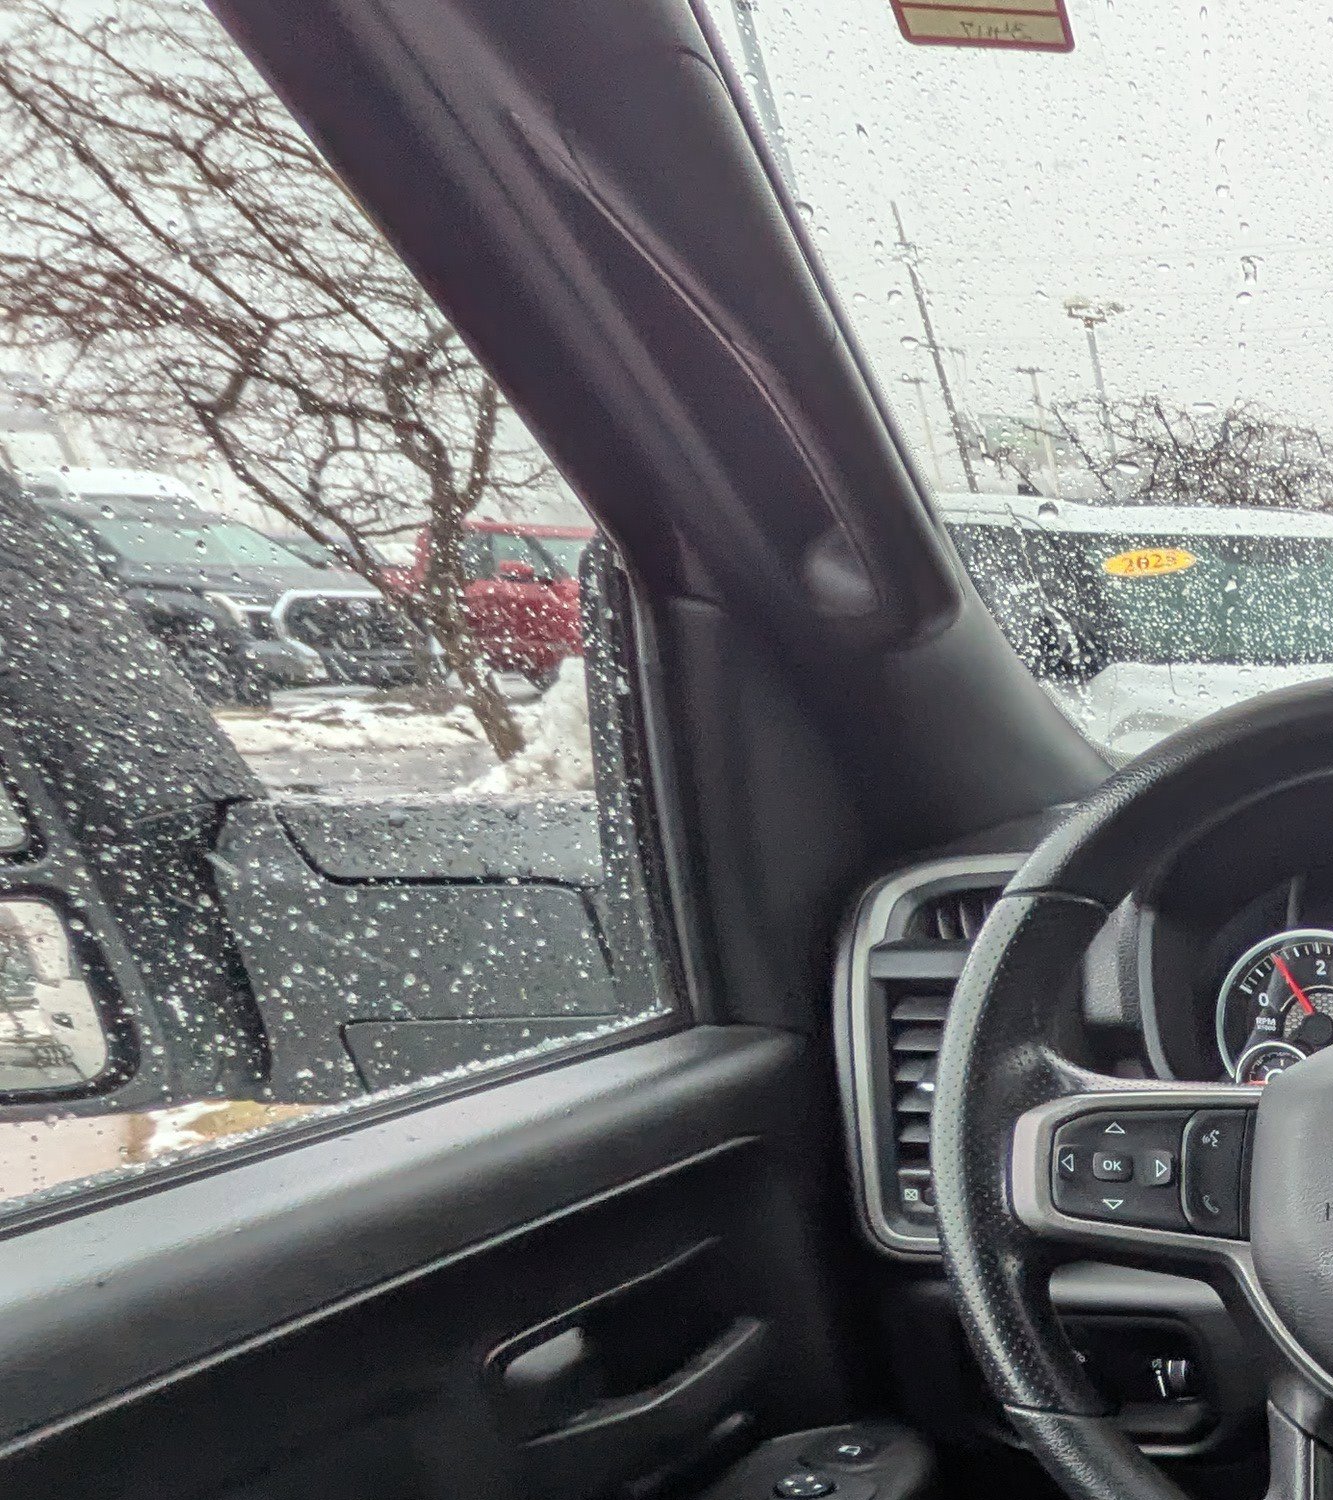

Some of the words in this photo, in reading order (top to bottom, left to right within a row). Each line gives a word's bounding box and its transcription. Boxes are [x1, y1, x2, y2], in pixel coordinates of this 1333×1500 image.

[1315, 960, 1327, 976] 2
[1258, 992, 1269, 1007] 0
[1256, 1017, 1276, 1026] RPM
[1103, 1160, 1122, 1172] OK
